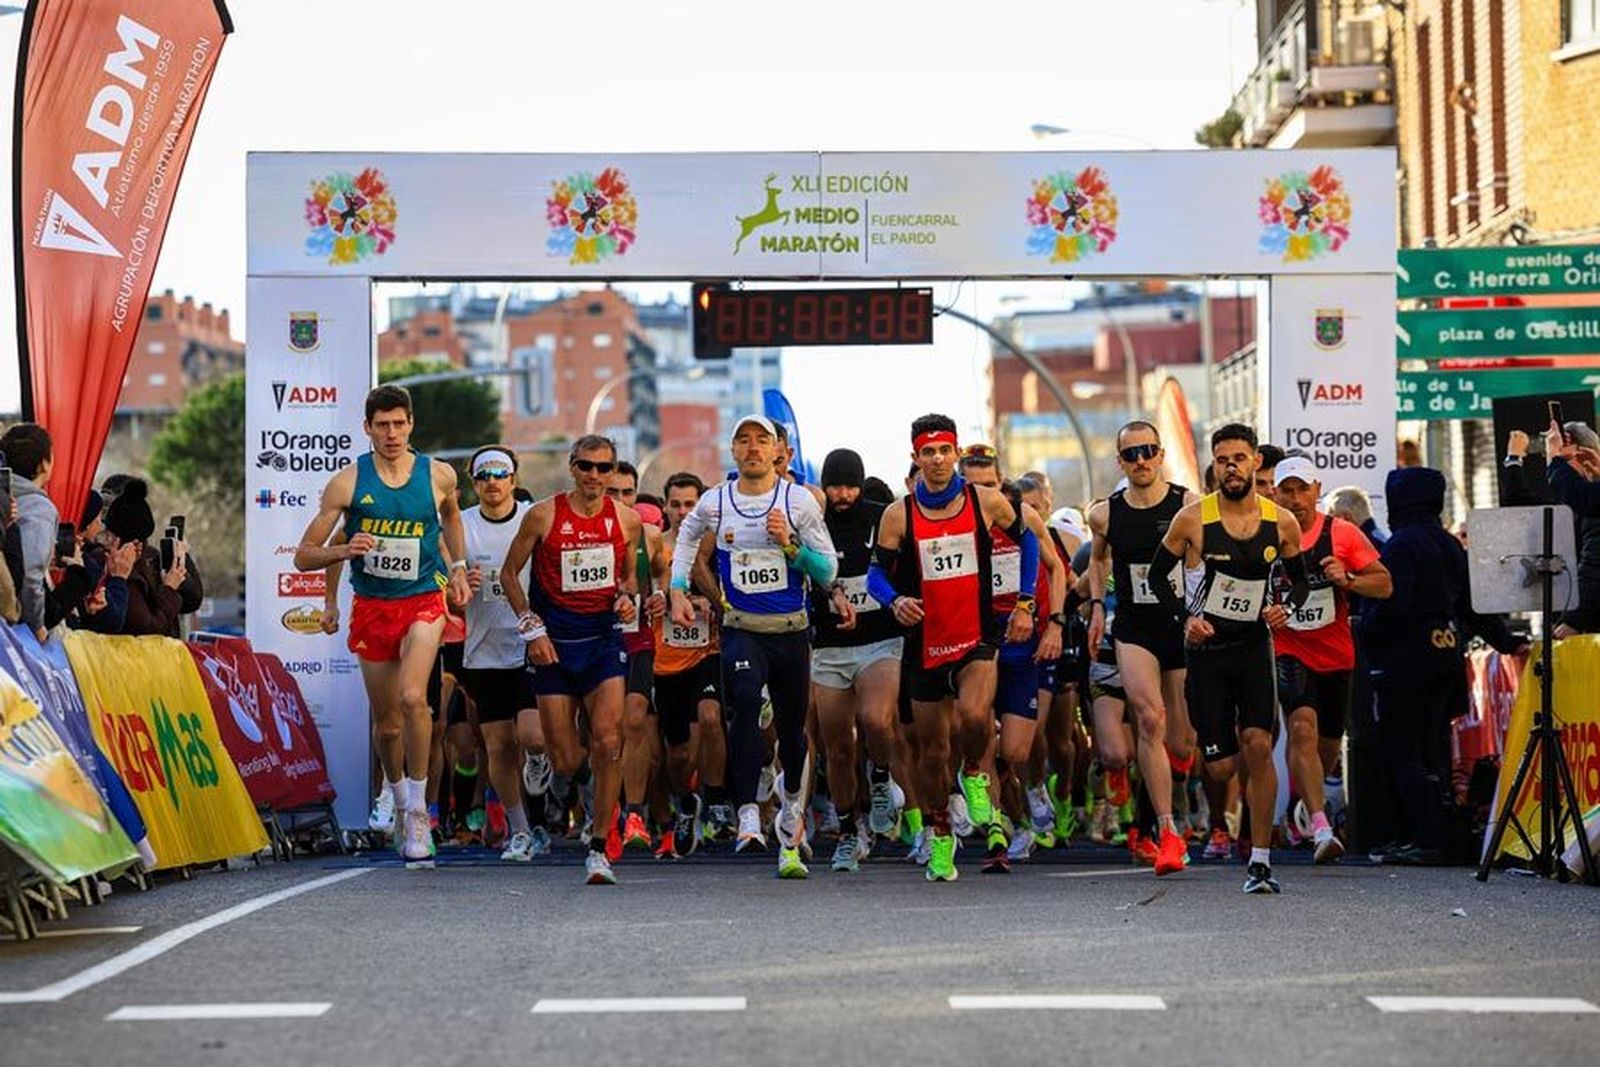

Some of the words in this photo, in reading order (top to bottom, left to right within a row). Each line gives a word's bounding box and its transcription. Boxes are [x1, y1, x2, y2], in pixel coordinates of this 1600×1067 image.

[71, 14, 161, 210] ADM
[111, 135, 145, 220] Atletismo
[139, 83, 162, 135] desde
[154, 38, 176, 80] 1959
[112, 225, 151, 334] AGRUPACIÓN
[140, 127, 182, 225] DEPORTIVA
[172, 36, 212, 133] MARATHON
[826, 171, 908, 193] EDICIÓN
[31, 188, 54, 247] MARATHON
[794, 207, 860, 225] MEDIO
[871, 214, 959, 227] FUENCARRAL
[760, 233, 860, 253] MARATÓN
[871, 233, 887, 245] EL
[890, 232, 937, 245] PARDO
[1505, 253, 1573, 267] avenida
[1434, 272, 1457, 289] C.
[1469, 270, 1550, 288] Herrera
[1564, 266, 1600, 285] Ori
[1439, 328, 1484, 343] plaza
[1494, 327, 1516, 340] de
[1526, 320, 1600, 339] Castill
[1313, 384, 1363, 400] ADM
[1427, 378, 1449, 392] de
[1459, 378, 1474, 392] la
[288, 386, 338, 403] ADM
[1396, 395, 1415, 412] la
[1429, 394, 1456, 411] de
[1469, 394, 1494, 410] Ja
[261, 431, 351, 455] l'Orange
[1286, 428, 1377, 452] l'Orange
[290, 453, 351, 472] bleue
[1315, 453, 1377, 469] bleue
[280, 491, 306, 507] fec
[371, 555, 412, 571] 1828
[934, 553, 963, 572] 317
[571, 566, 608, 583] 1938
[739, 568, 779, 585] 1063
[846, 593, 867, 605] 47
[1222, 597, 1250, 613] 153
[1295, 607, 1324, 623] 667
[673, 627, 700, 640] 538
[284, 661, 322, 675] ADRID
